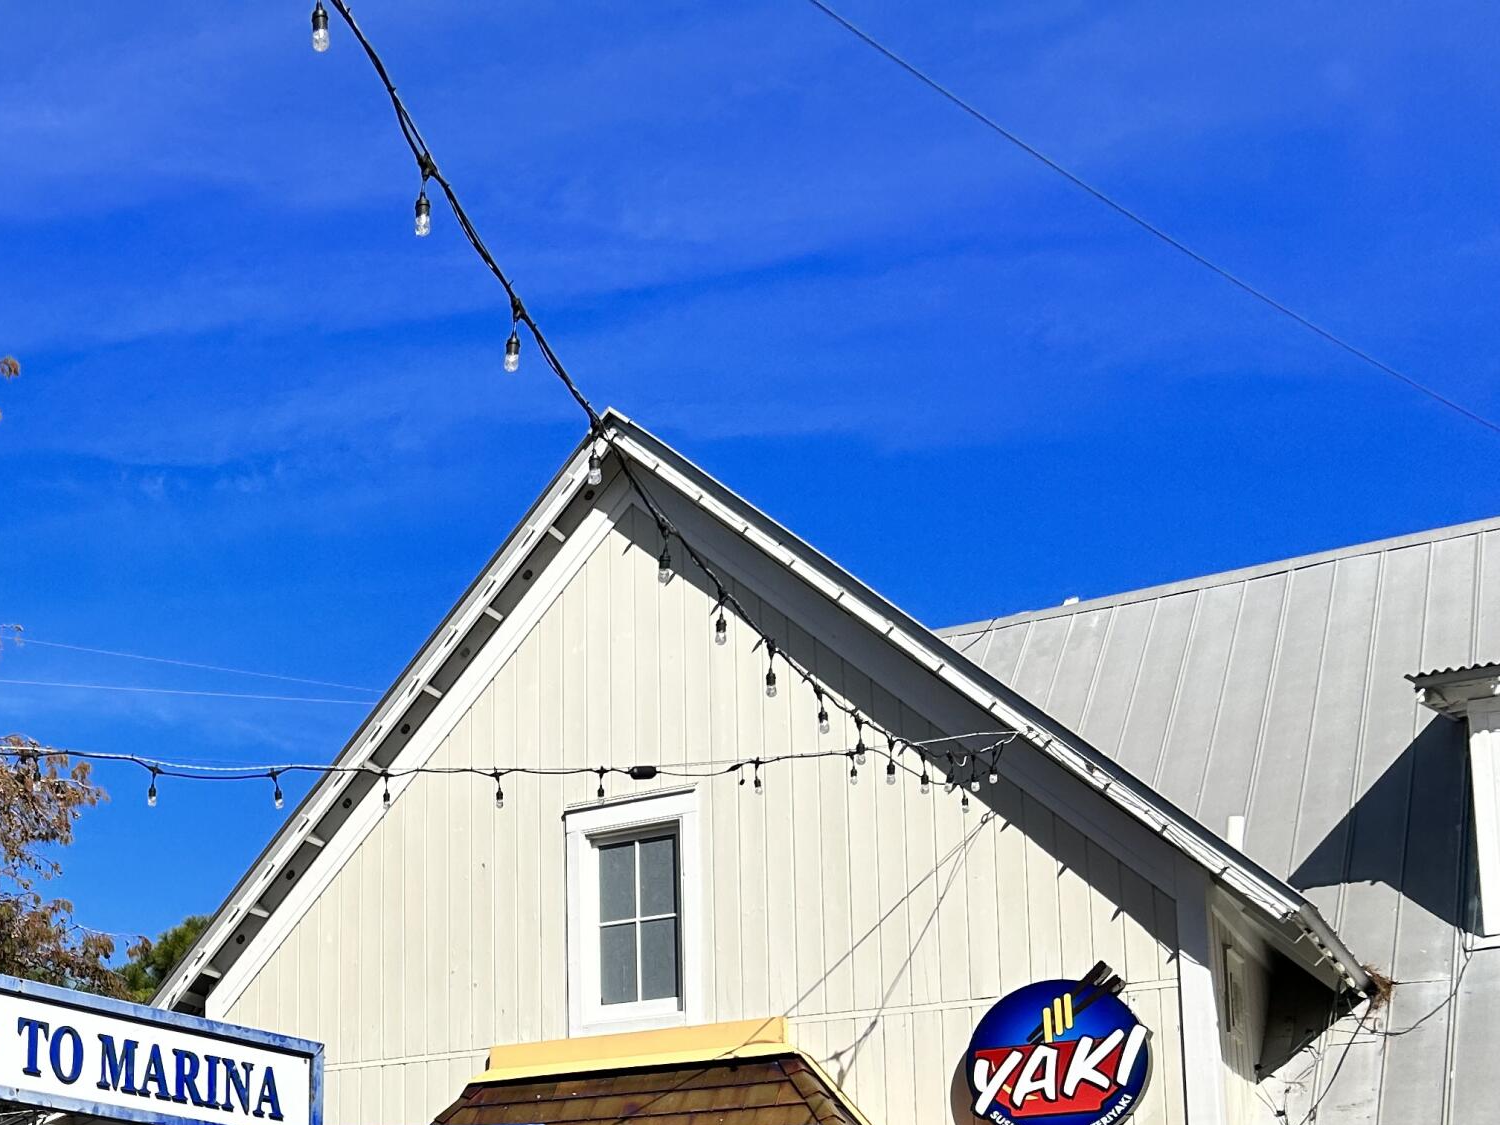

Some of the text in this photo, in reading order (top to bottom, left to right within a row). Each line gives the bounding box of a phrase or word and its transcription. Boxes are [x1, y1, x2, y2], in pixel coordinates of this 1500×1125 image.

[16, 1016, 285, 1122] TO MARINA
[973, 1023, 1148, 1116] YAKI
